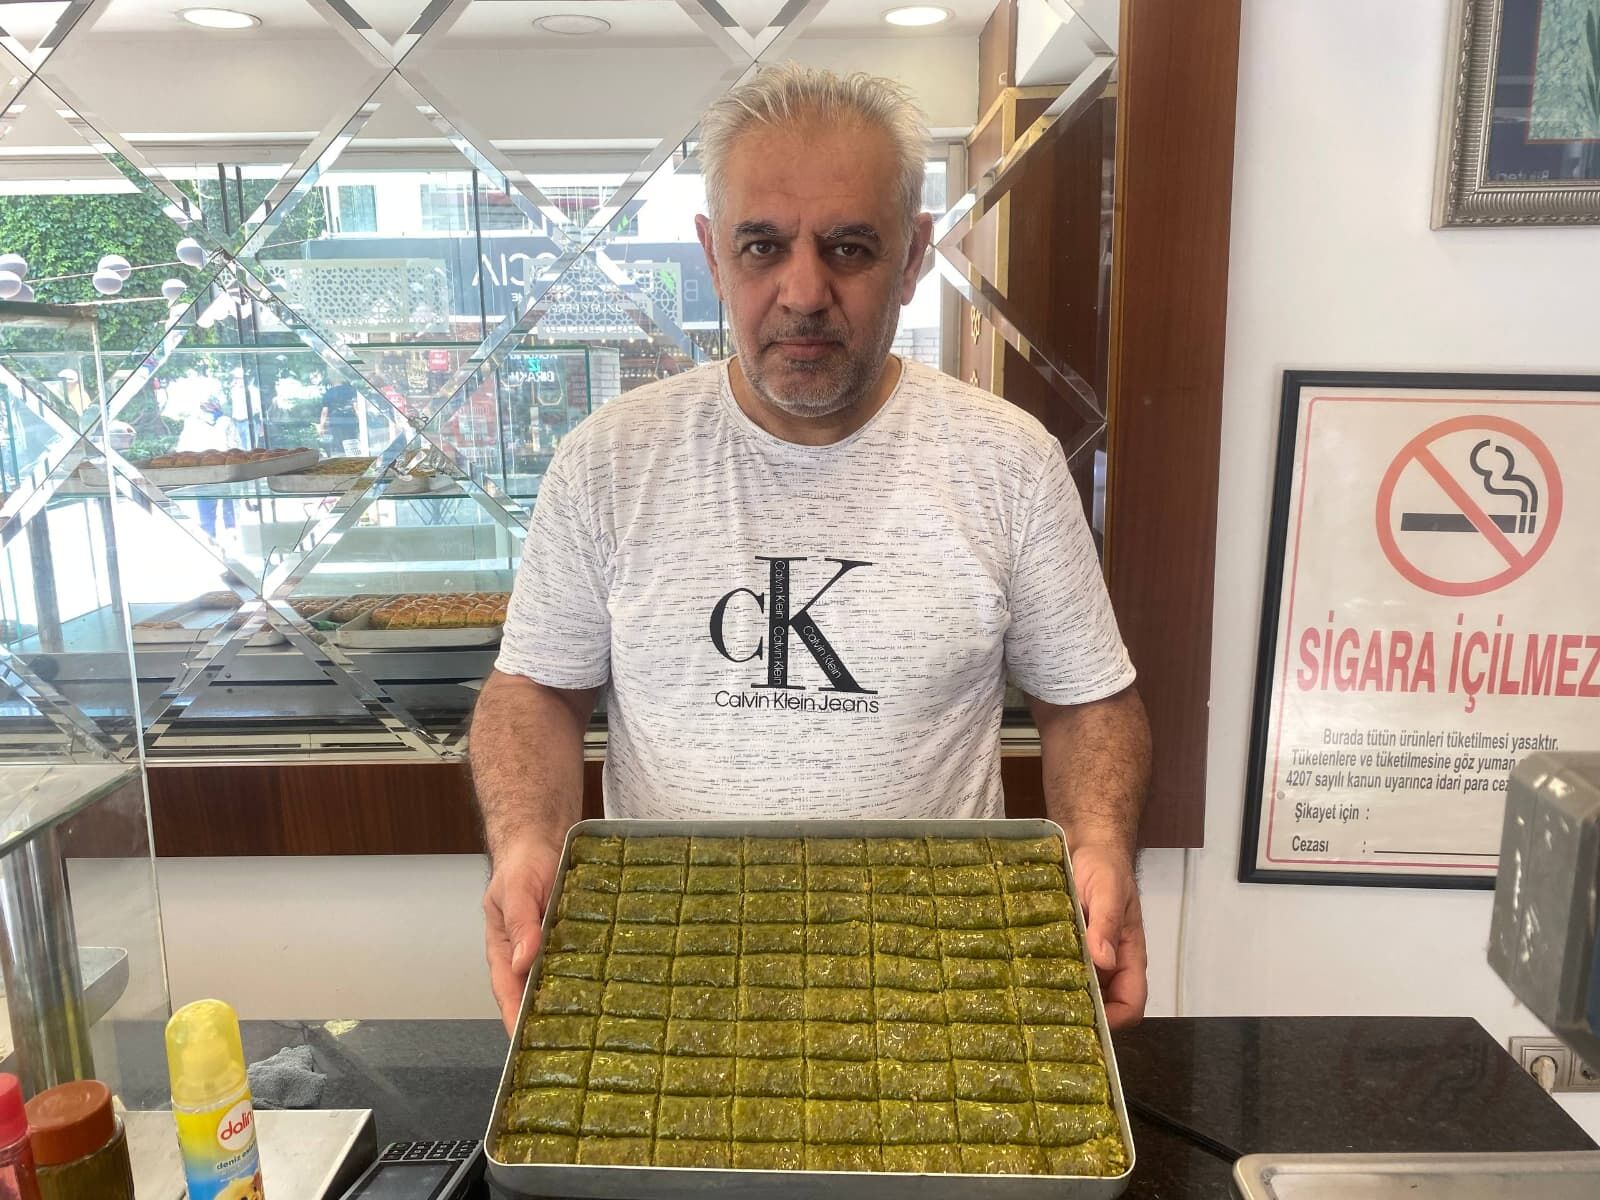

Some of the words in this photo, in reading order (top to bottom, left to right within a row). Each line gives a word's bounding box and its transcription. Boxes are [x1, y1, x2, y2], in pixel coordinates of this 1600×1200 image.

[774, 560, 786, 594] Calvin
[775, 595, 786, 619] Klein
[709, 556, 878, 694] CK
[773, 626, 785, 658] Calvin
[803, 625, 826, 658] Calvin
[822, 653, 842, 679] Klein
[772, 659, 785, 685] Klein
[1296, 610, 1435, 693] SİGARA
[1448, 613, 1600, 714] İÇİLMEZ
[715, 690, 769, 708] Calvin
[773, 691, 815, 711] Klein
[818, 695, 879, 713] Jeans
[1323, 729, 1363, 746] Burada
[1367, 731, 1396, 747] tütün
[1400, 730, 1444, 748] ürünleri
[1447, 732, 1509, 750] tüketilmesi
[1511, 733, 1559, 753] yasaktır.
[1292, 749, 1356, 767] Tüketenlere
[1360, 755, 1372, 767] ve
[1376, 751, 1450, 769] tüketilmesine
[1453, 754, 1474, 772] göz
[1477, 758, 1515, 773] yuman
[1286, 771, 1312, 786] 4207
[1315, 772, 1344, 790] sayılı
[1347, 773, 1381, 789] kanun
[1385, 775, 1432, 793] uyarınca
[1435, 774, 1461, 791] idari
[1464, 779, 1488, 795] para
[1295, 803, 1336, 823] Şikayet
[1338, 804, 1359, 824] için
[1292, 835, 1329, 853] Cezası
[220, 1111, 252, 1140] dalin
[216, 1154, 241, 1170] deniz
